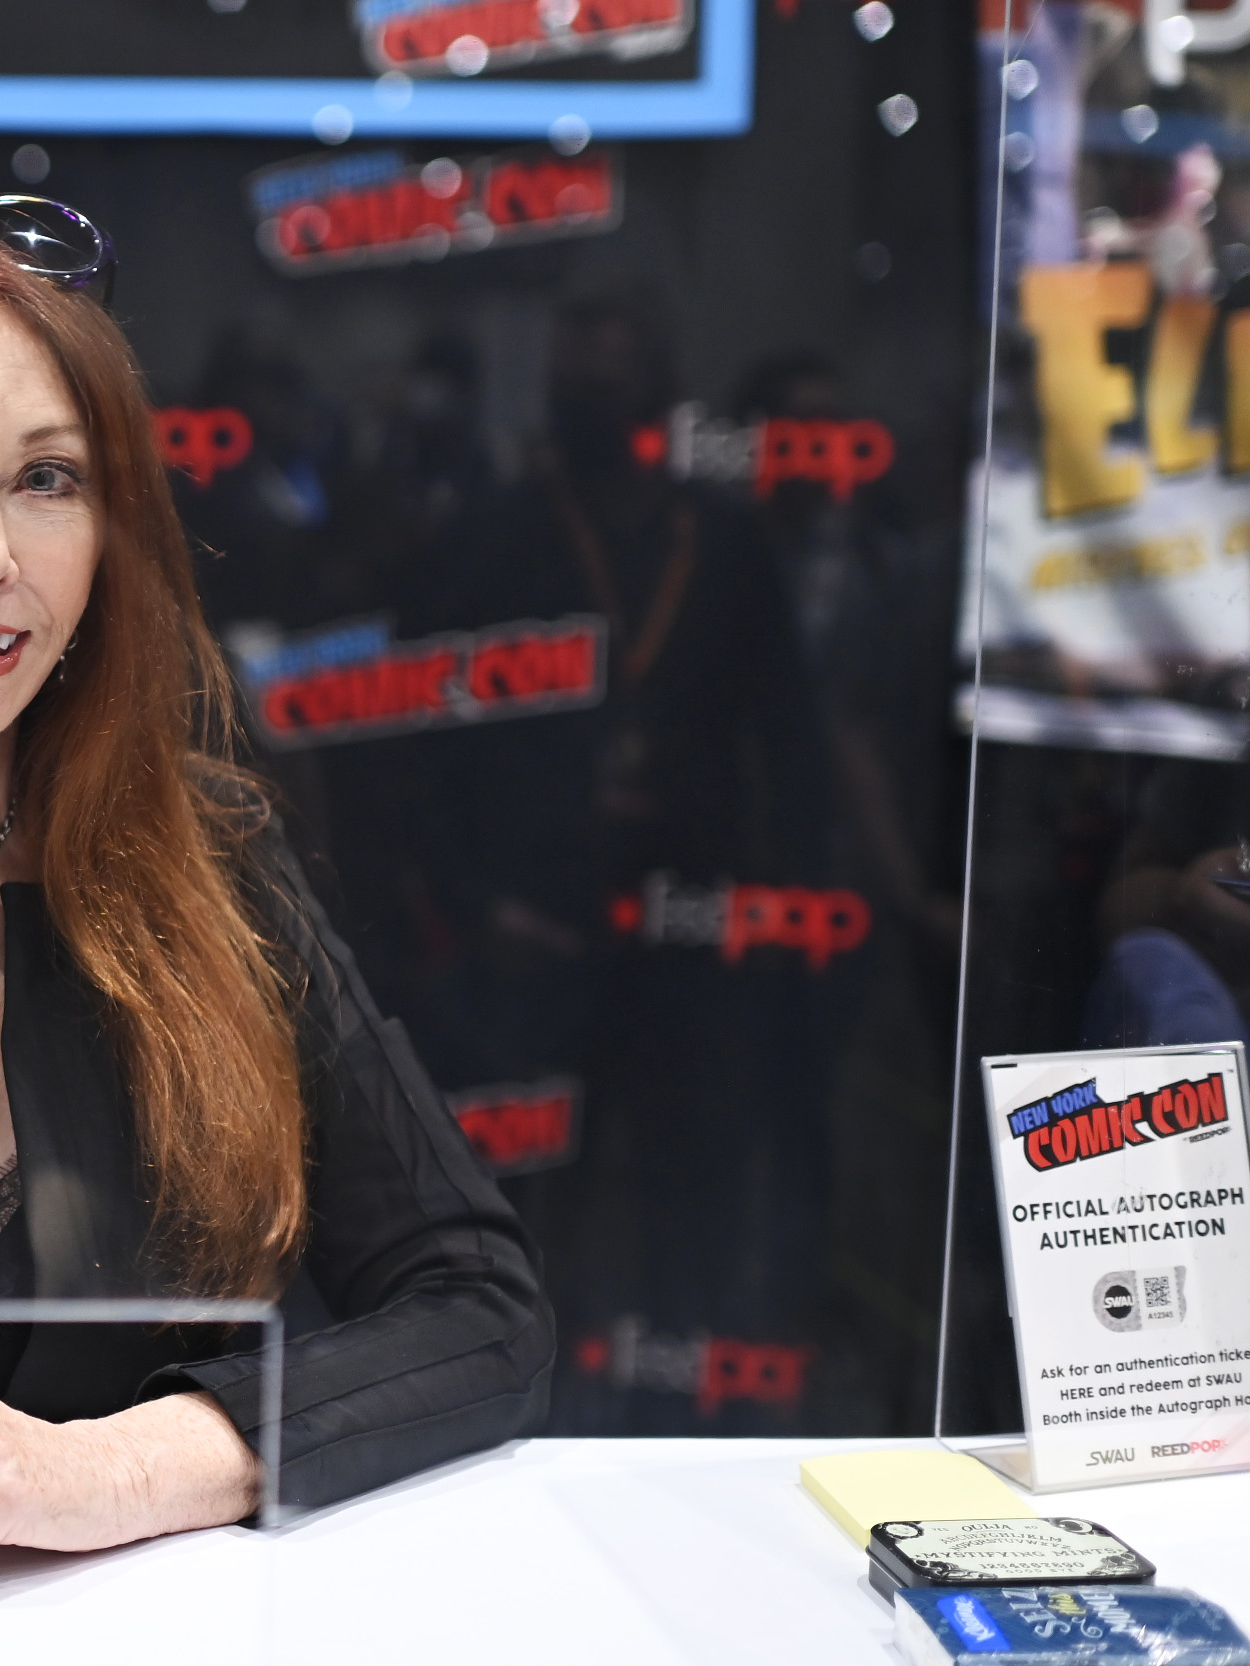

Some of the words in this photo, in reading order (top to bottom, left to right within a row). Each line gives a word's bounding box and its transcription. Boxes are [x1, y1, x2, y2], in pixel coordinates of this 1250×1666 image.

[1010, 1100, 1051, 1136] NEW
[1050, 1081, 1099, 1118] YORK
[1027, 1096, 1146, 1169] COMIC
[1151, 1075, 1228, 1135] CON
[1012, 1197, 1110, 1223] OFFICIAL
[1115, 1186, 1246, 1216] AUTOGRAPH
[1039, 1217, 1227, 1251] AUTHENTICATION
[1103, 1293, 1136, 1309] SWAU
[1040, 1365, 1065, 1380] Ask
[1069, 1363, 1090, 1377] for
[1093, 1362, 1112, 1375] an
[1115, 1352, 1217, 1373] authentication
[1060, 1386, 1095, 1401] HERE
[1098, 1383, 1126, 1397] and
[1129, 1377, 1184, 1395] redeem
[1187, 1375, 1201, 1389] at
[1205, 1372, 1243, 1386] SWAU
[1042, 1409, 1082, 1426] Booth
[1085, 1405, 1127, 1422] inside
[1130, 1403, 1153, 1418] the
[1157, 1395, 1231, 1415] Autograph
[1085, 1447, 1136, 1467] SWAU
[961, 1522, 1014, 1533] OUIJA
[1051, 1546, 1118, 1558] MINTS
